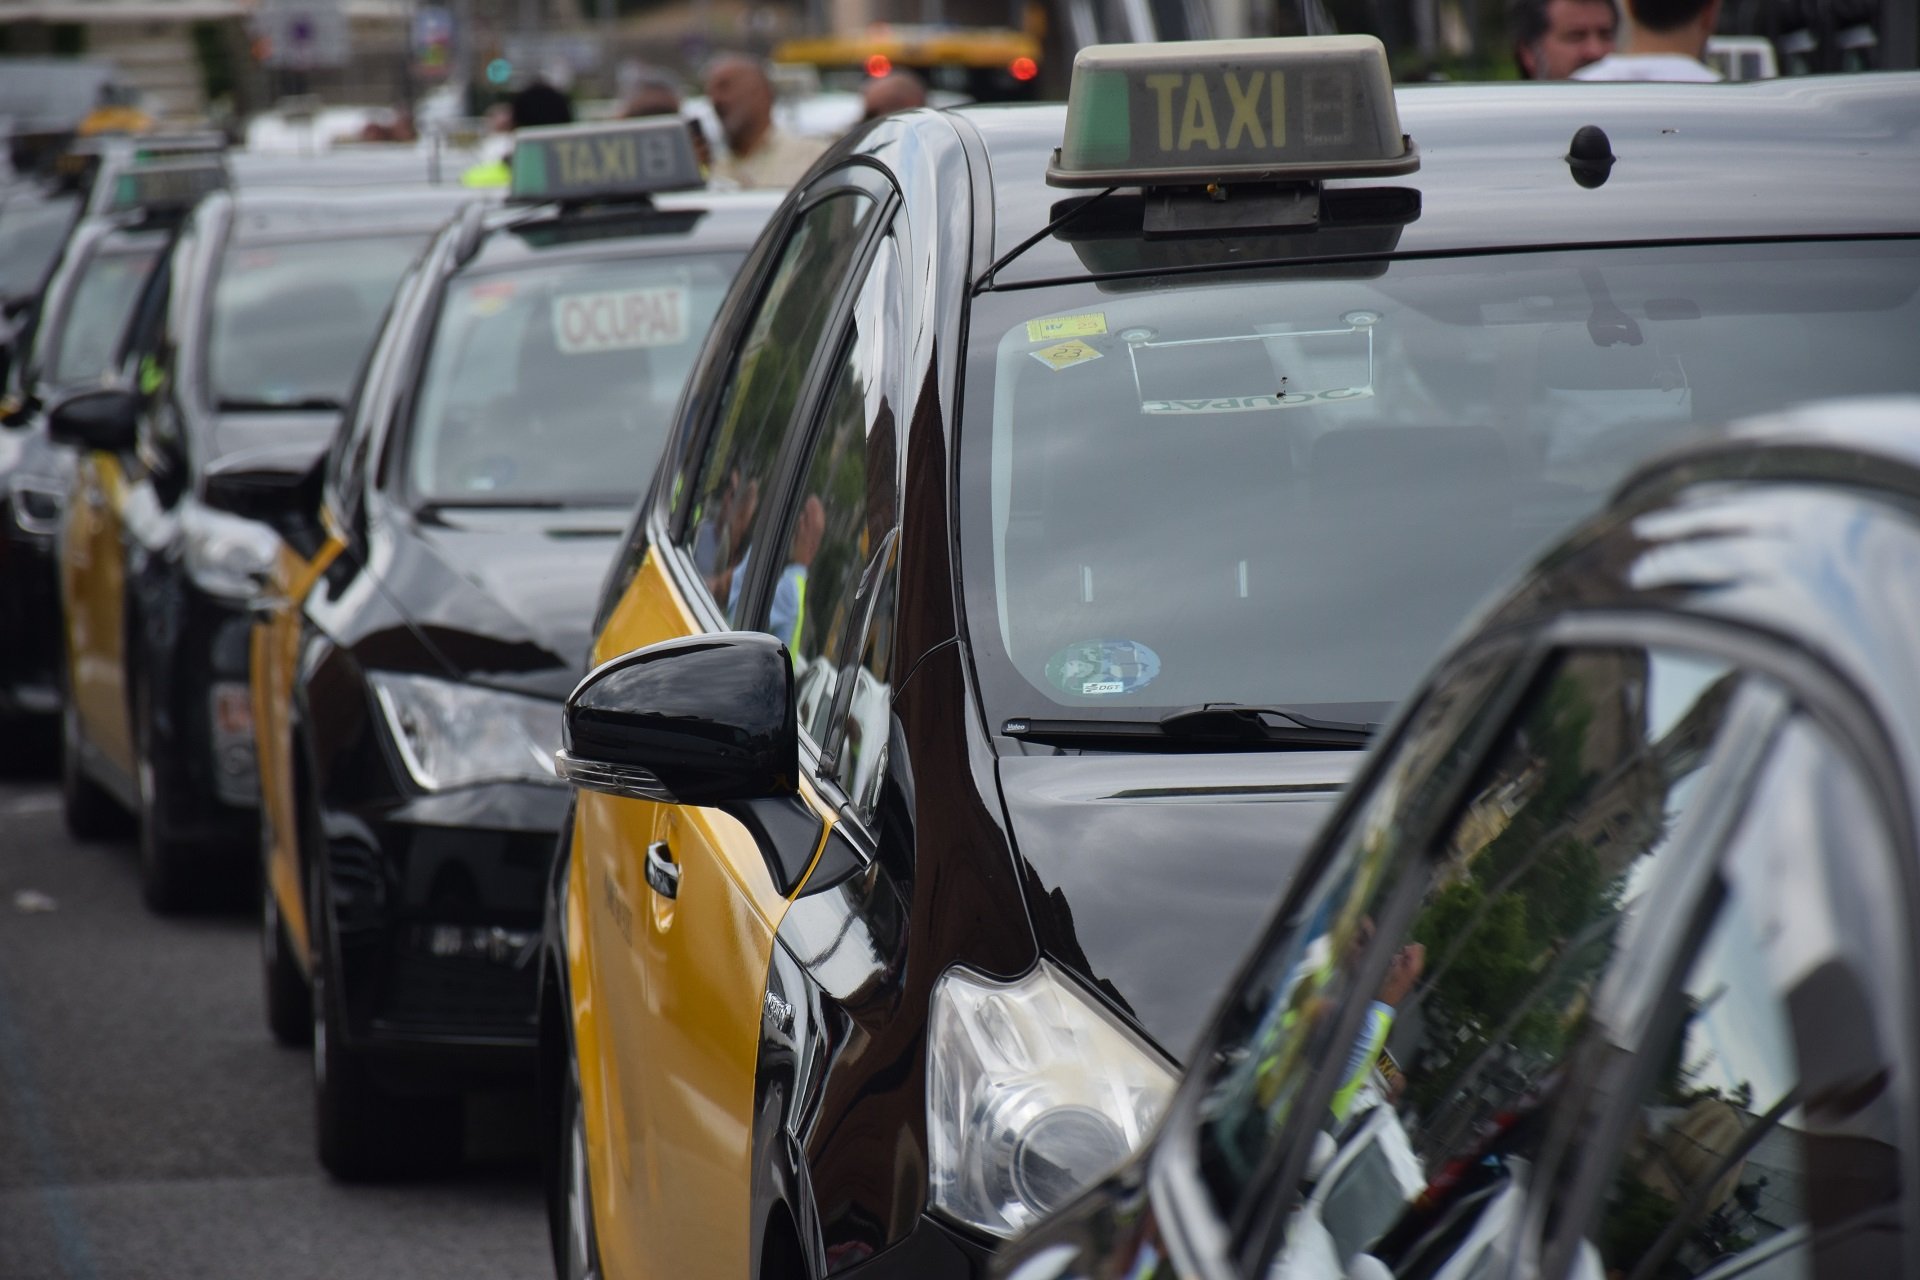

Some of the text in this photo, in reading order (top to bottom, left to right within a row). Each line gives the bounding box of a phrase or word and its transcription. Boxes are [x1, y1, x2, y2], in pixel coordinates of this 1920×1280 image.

[1146, 71, 1287, 151] TAXI
[556, 138, 638, 186] TAXI
[563, 290, 680, 344] OCUPAT
[1152, 388, 1362, 411] OCUPAT
